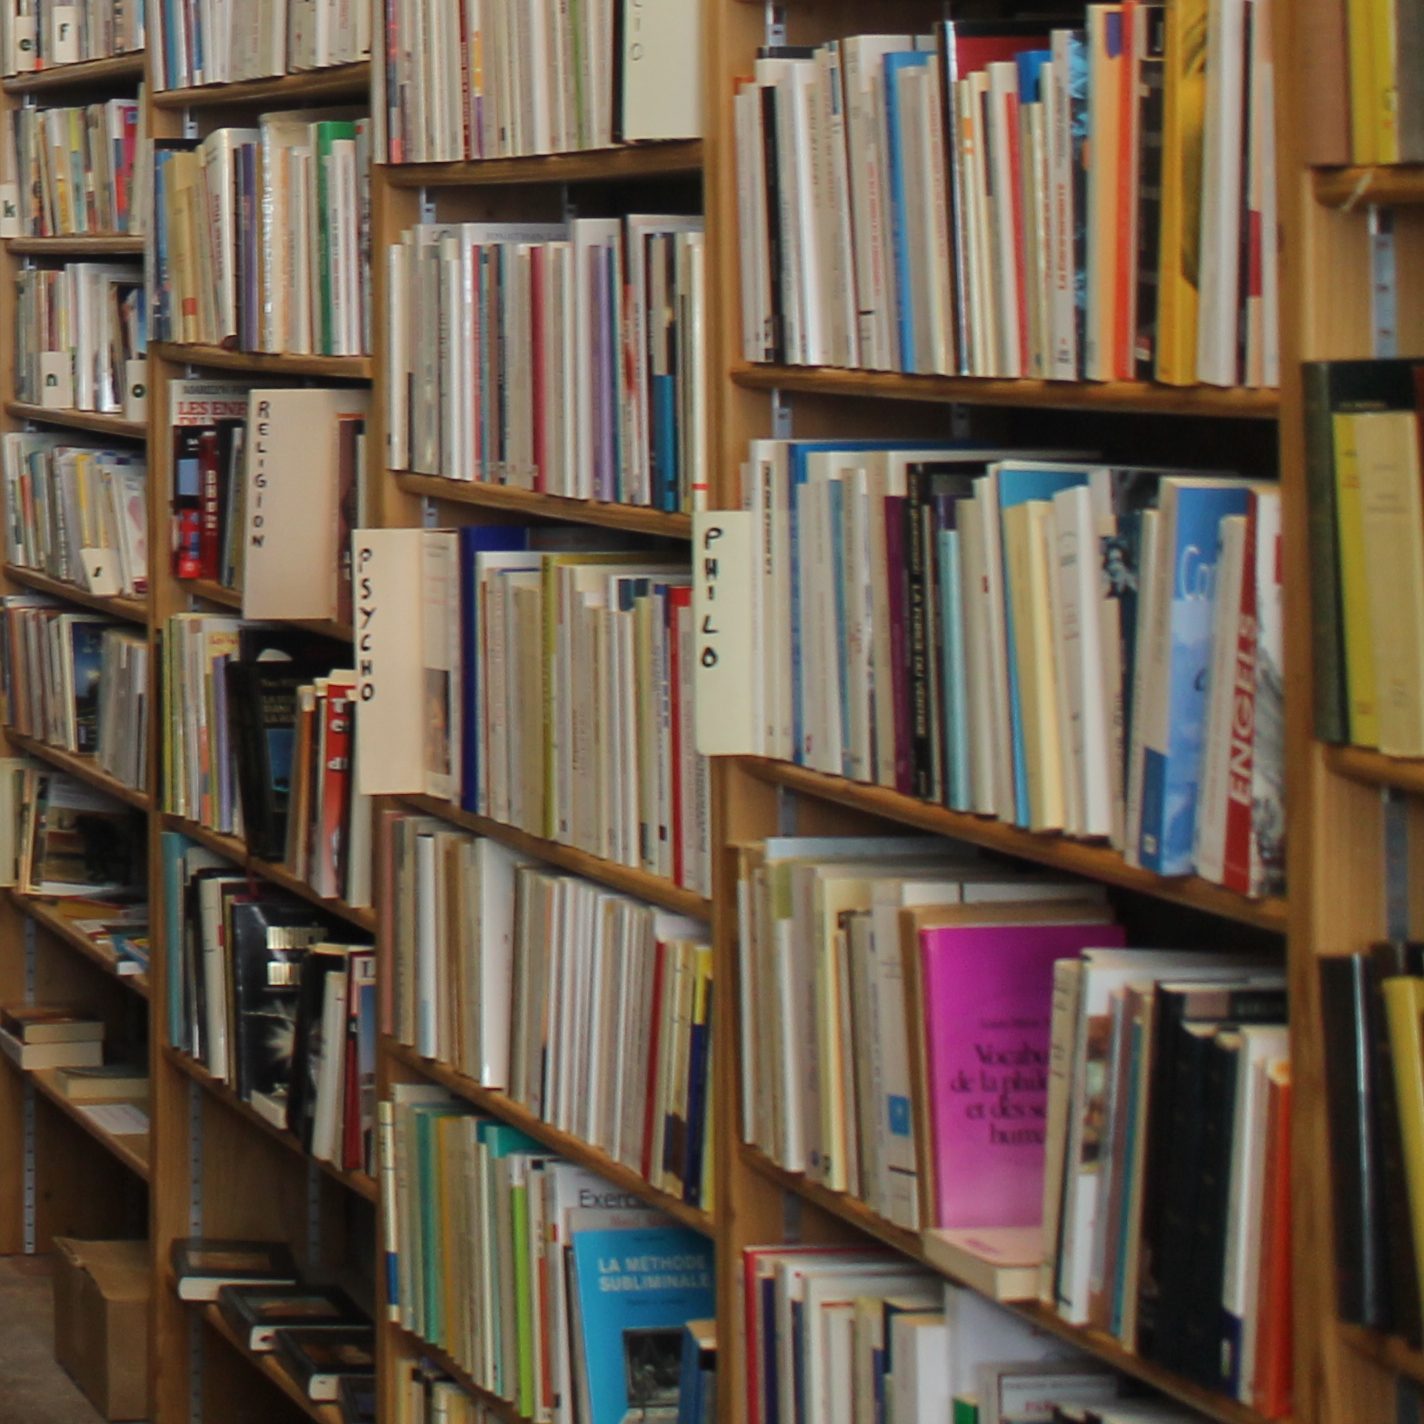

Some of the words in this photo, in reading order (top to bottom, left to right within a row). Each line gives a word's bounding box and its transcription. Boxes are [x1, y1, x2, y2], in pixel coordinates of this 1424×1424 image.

[19, 38, 32, 51] e
[3, 199, 17, 218] k
[45, 373, 58, 387] n
[132, 384, 146, 398] o
[178, 401, 209, 415] LES
[252, 400, 271, 547] RELIGION
[702, 527, 723, 668] PHILO
[357, 547, 377, 702] PSYCHO
[1228, 613, 1257, 807] ENGELS
[598, 1257, 621, 1274] LA
[599, 1273, 710, 1292] SUBLIMINALE
